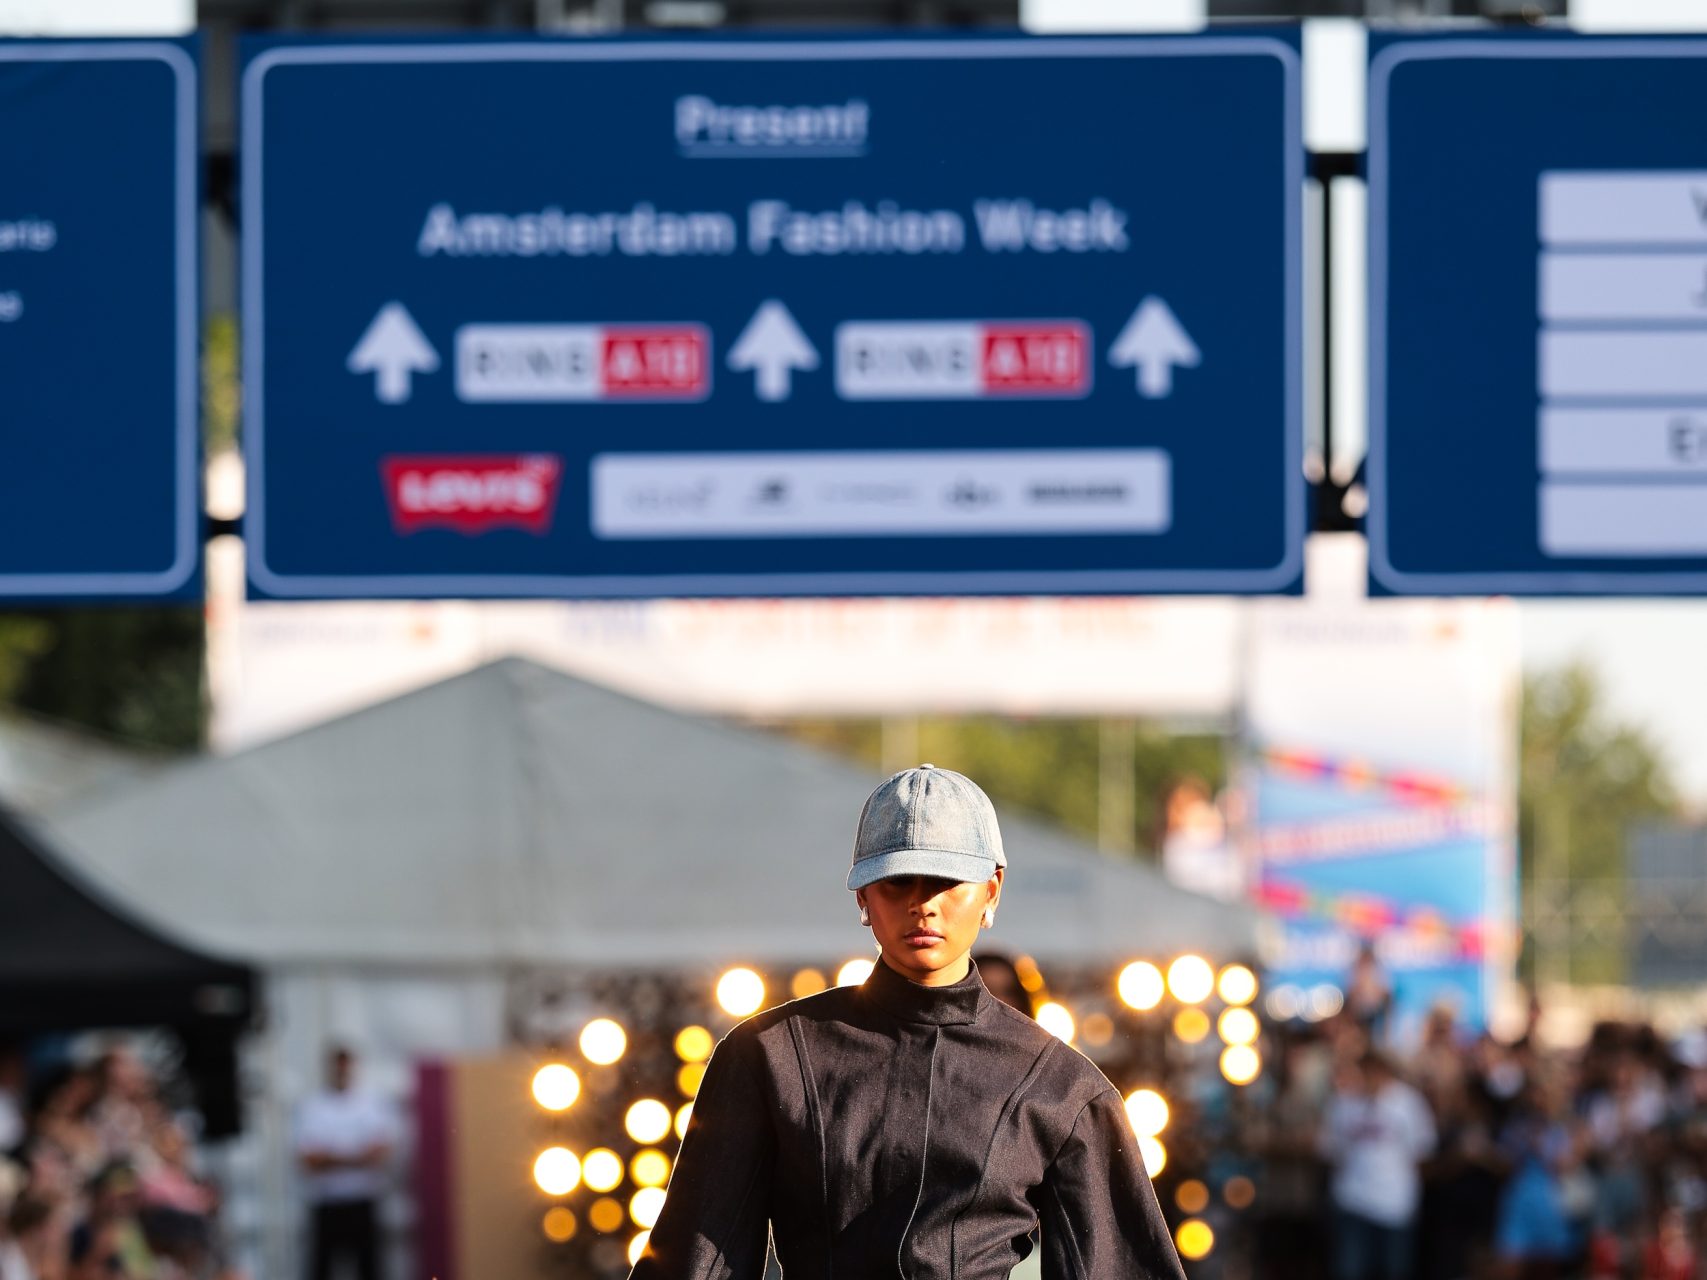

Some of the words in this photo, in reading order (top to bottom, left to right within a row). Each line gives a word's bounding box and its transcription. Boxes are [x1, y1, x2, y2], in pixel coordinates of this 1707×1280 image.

[677, 97, 867, 145] Present
[419, 203, 735, 255] Amsterdam
[750, 202, 962, 253] Fashion
[976, 200, 1129, 251] Week
